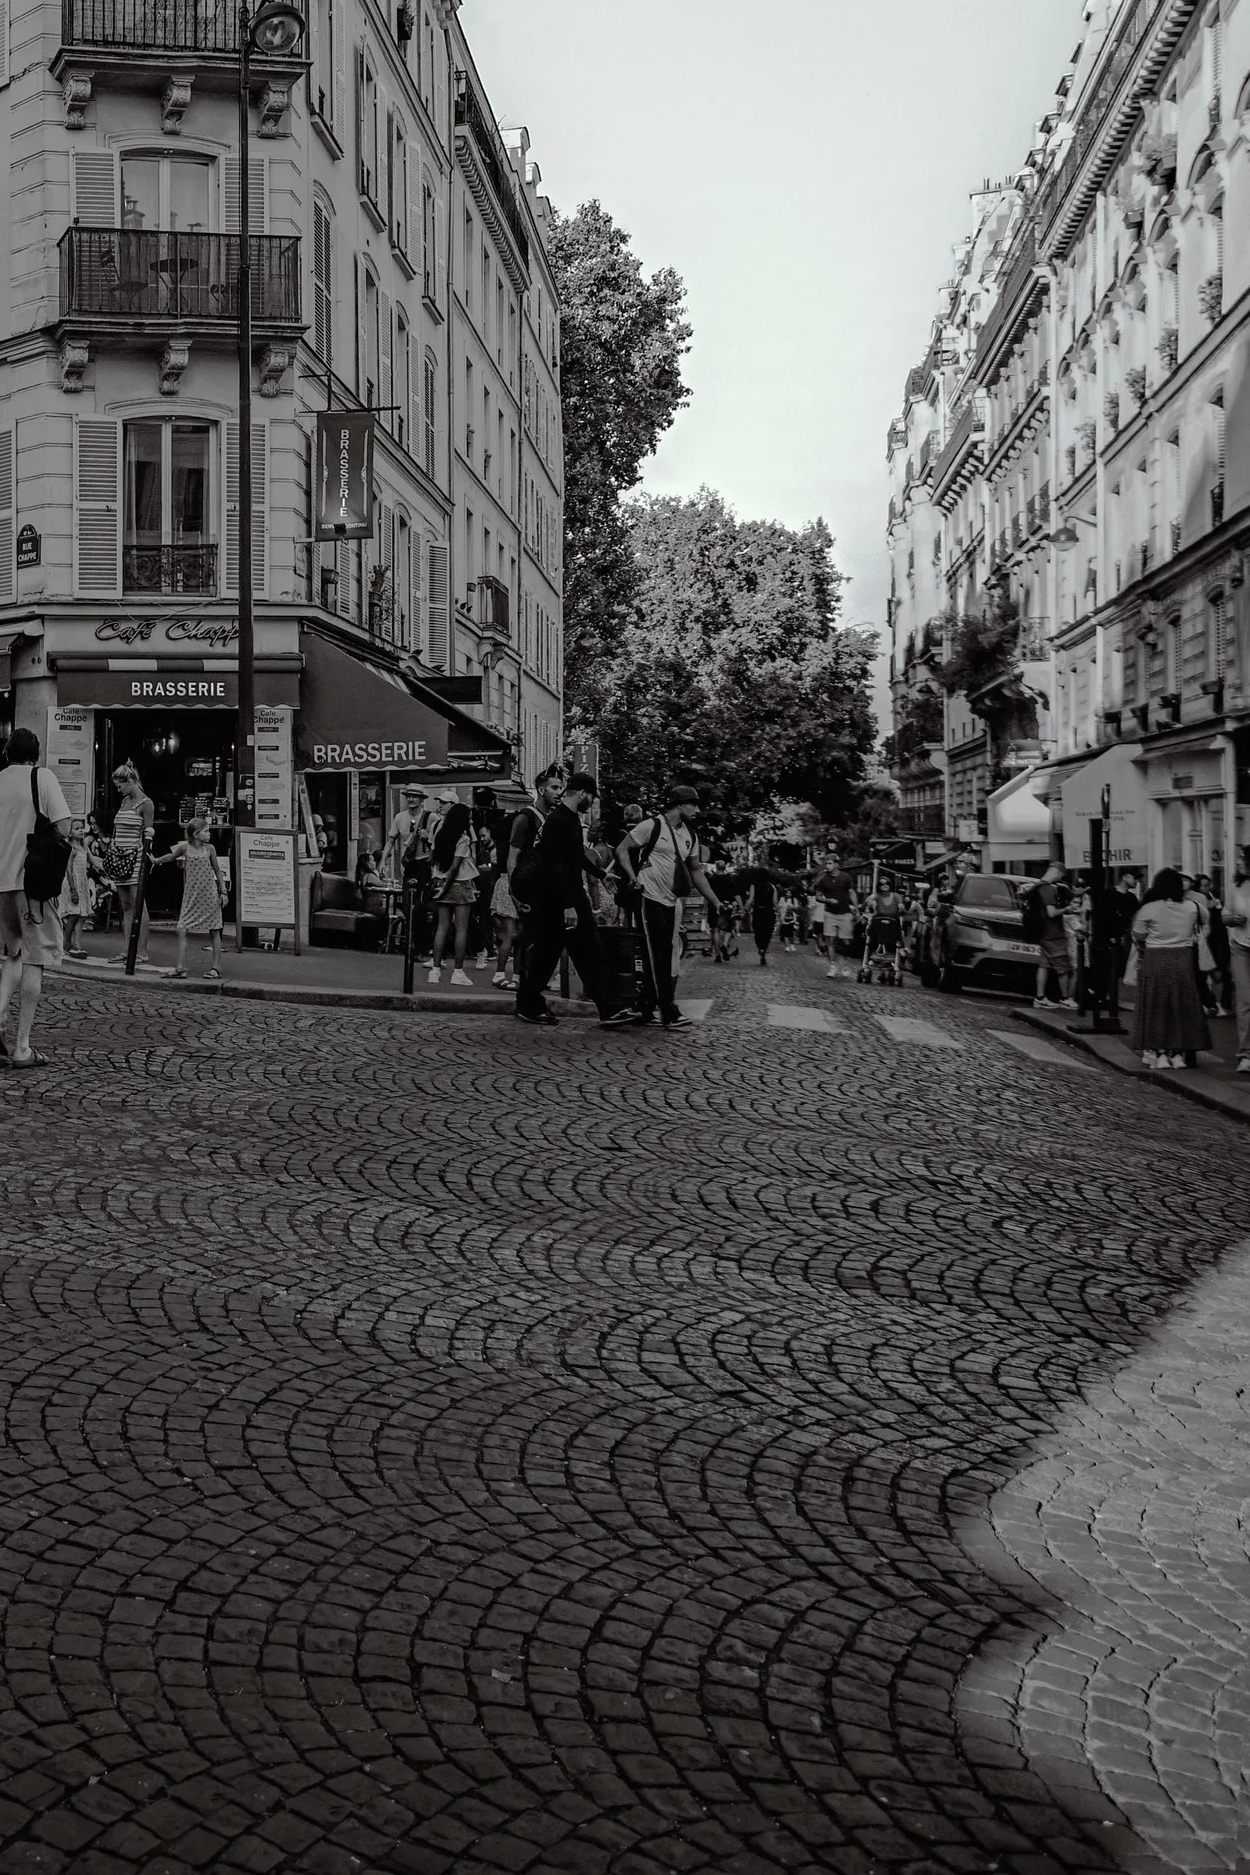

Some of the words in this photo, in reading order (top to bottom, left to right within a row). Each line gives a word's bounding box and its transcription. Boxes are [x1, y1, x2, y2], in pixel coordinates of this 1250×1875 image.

[339, 429, 349, 517] BRASSERIE
[22, 541, 32, 551] RUE
[18, 551, 37, 562] CHAPPE
[95, 618, 156, 645] Café
[165, 618, 240, 647] Chapp
[131, 681, 225, 696] BRASSERIE
[54, 713, 87, 723] Chappe
[313, 740, 427, 764] BRASSERIE
[253, 839, 281, 848] Chappe
